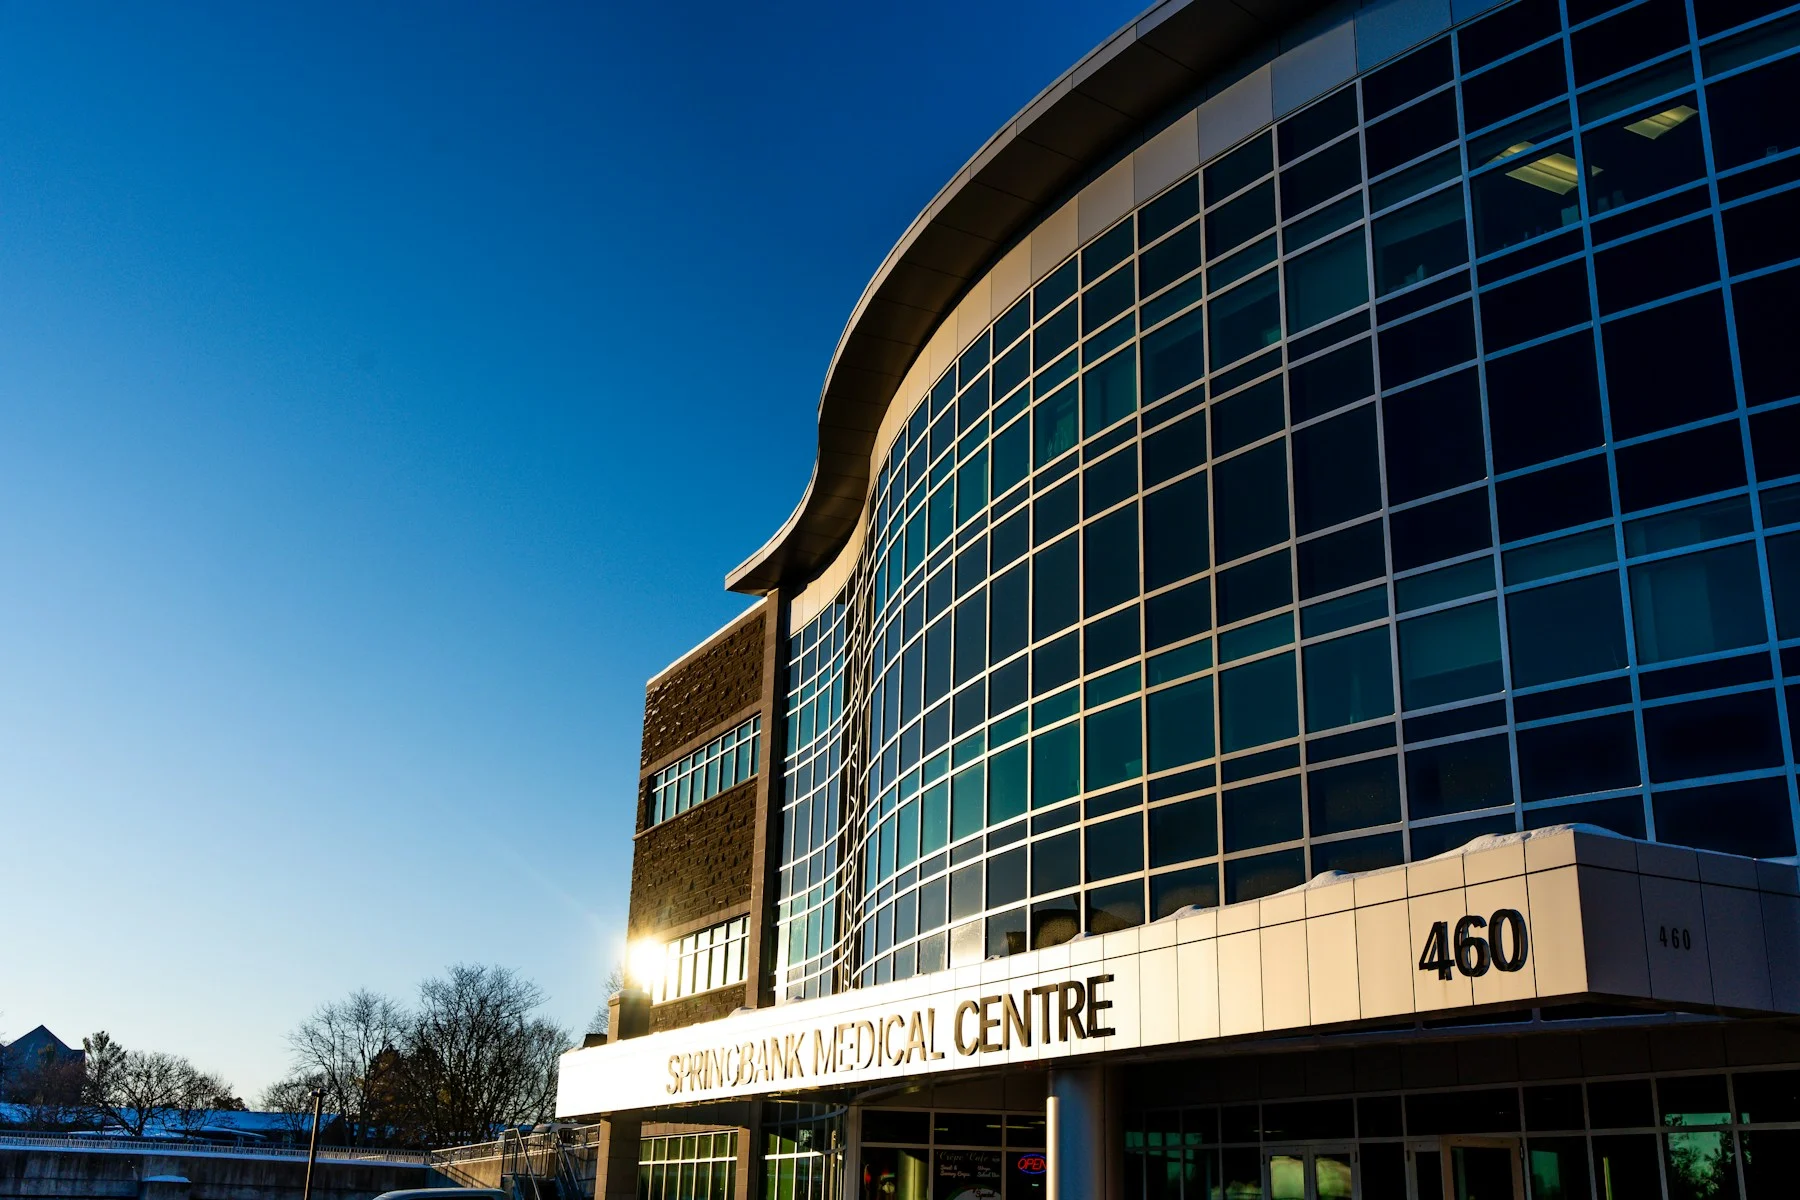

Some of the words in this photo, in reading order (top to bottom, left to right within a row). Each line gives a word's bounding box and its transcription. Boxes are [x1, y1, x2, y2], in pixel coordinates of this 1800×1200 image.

[1419, 909, 1528, 980] 460
[1659, 925, 1691, 950] 460
[666, 1031, 805, 1094] SPRINGBANK
[813, 1007, 945, 1076] MEDICAL
[954, 974, 1116, 1056] CENTRE
[1017, 1158, 1047, 1170] OPEN
